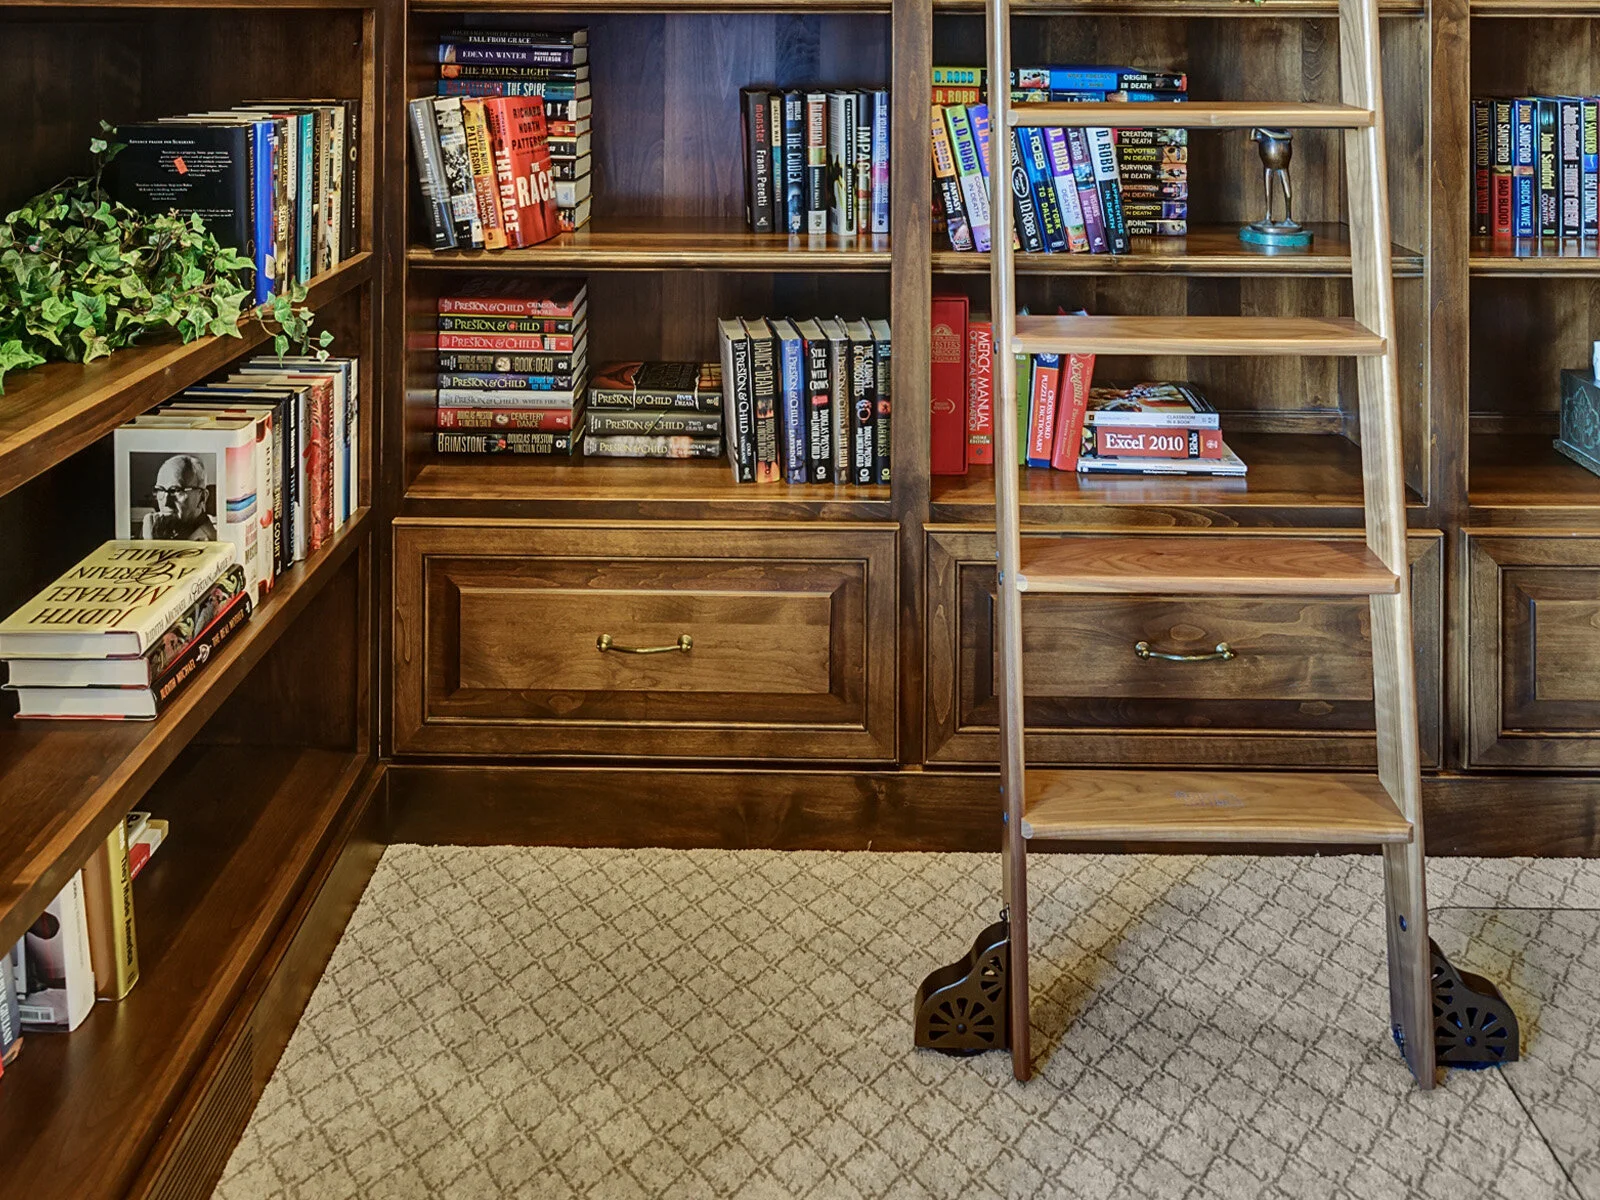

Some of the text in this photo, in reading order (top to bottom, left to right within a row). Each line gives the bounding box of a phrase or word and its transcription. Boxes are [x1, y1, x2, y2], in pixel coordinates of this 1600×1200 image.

[462, 50, 483, 60] EDEN
[496, 50, 528, 61] WINTER
[506, 81, 547, 98] THE SPIRE
[1122, 73, 1148, 81] ORIGIN
[1497, 103, 1511, 122] JOHN
[466, 125, 482, 176] PATTERSON
[1121, 130, 1153, 138] CREATION
[1497, 123, 1511, 163] SANDFORD
[755, 104, 769, 208] monster Frank Peretti
[786, 131, 802, 184] THE CODEX
[856, 126, 871, 179] IMPACT
[1030, 136, 1046, 171] ROBB
[1518, 104, 1532, 226] JOHN SANDFORD SHOCK WAVE
[1541, 132, 1556, 190] John Sandford
[495, 146, 520, 234] THE RACE
[516, 170, 557, 209] RACE
[950, 181, 963, 212] FANTASY
[278, 204, 287, 242] SECRETS
[1041, 202, 1054, 235] DALLAS
[1106, 202, 1116, 229] DEATH
[1111, 182, 1124, 235] APPRENTICE
[1541, 193, 1549, 226] COUNTRY
[1131, 226, 1152, 234] DEATH
[454, 319, 495, 331] PRESTON
[451, 336, 493, 350] PRESTON
[504, 339, 540, 350] CHILD
[753, 341, 773, 367] DANCE
[734, 351, 747, 392] PRESTON
[755, 370, 774, 396] DEATH
[977, 330, 991, 430] MERCK MANUAL
[1069, 356, 1084, 405] SCRABBLE
[739, 401, 749, 434] CHILD
[1035, 374, 1049, 452] PUZZLE DICTIONARY
[1044, 389, 1055, 439] CROSSWORD
[438, 432, 487, 454] BRIMSTONE
[877, 418, 887, 457] DARKNESS
[1104, 433, 1184, 452] Excel 2010
[1188, 432, 1198, 456] Bible
[274, 522, 282, 558] COURT
[28, 605, 144, 629] JUDITH
